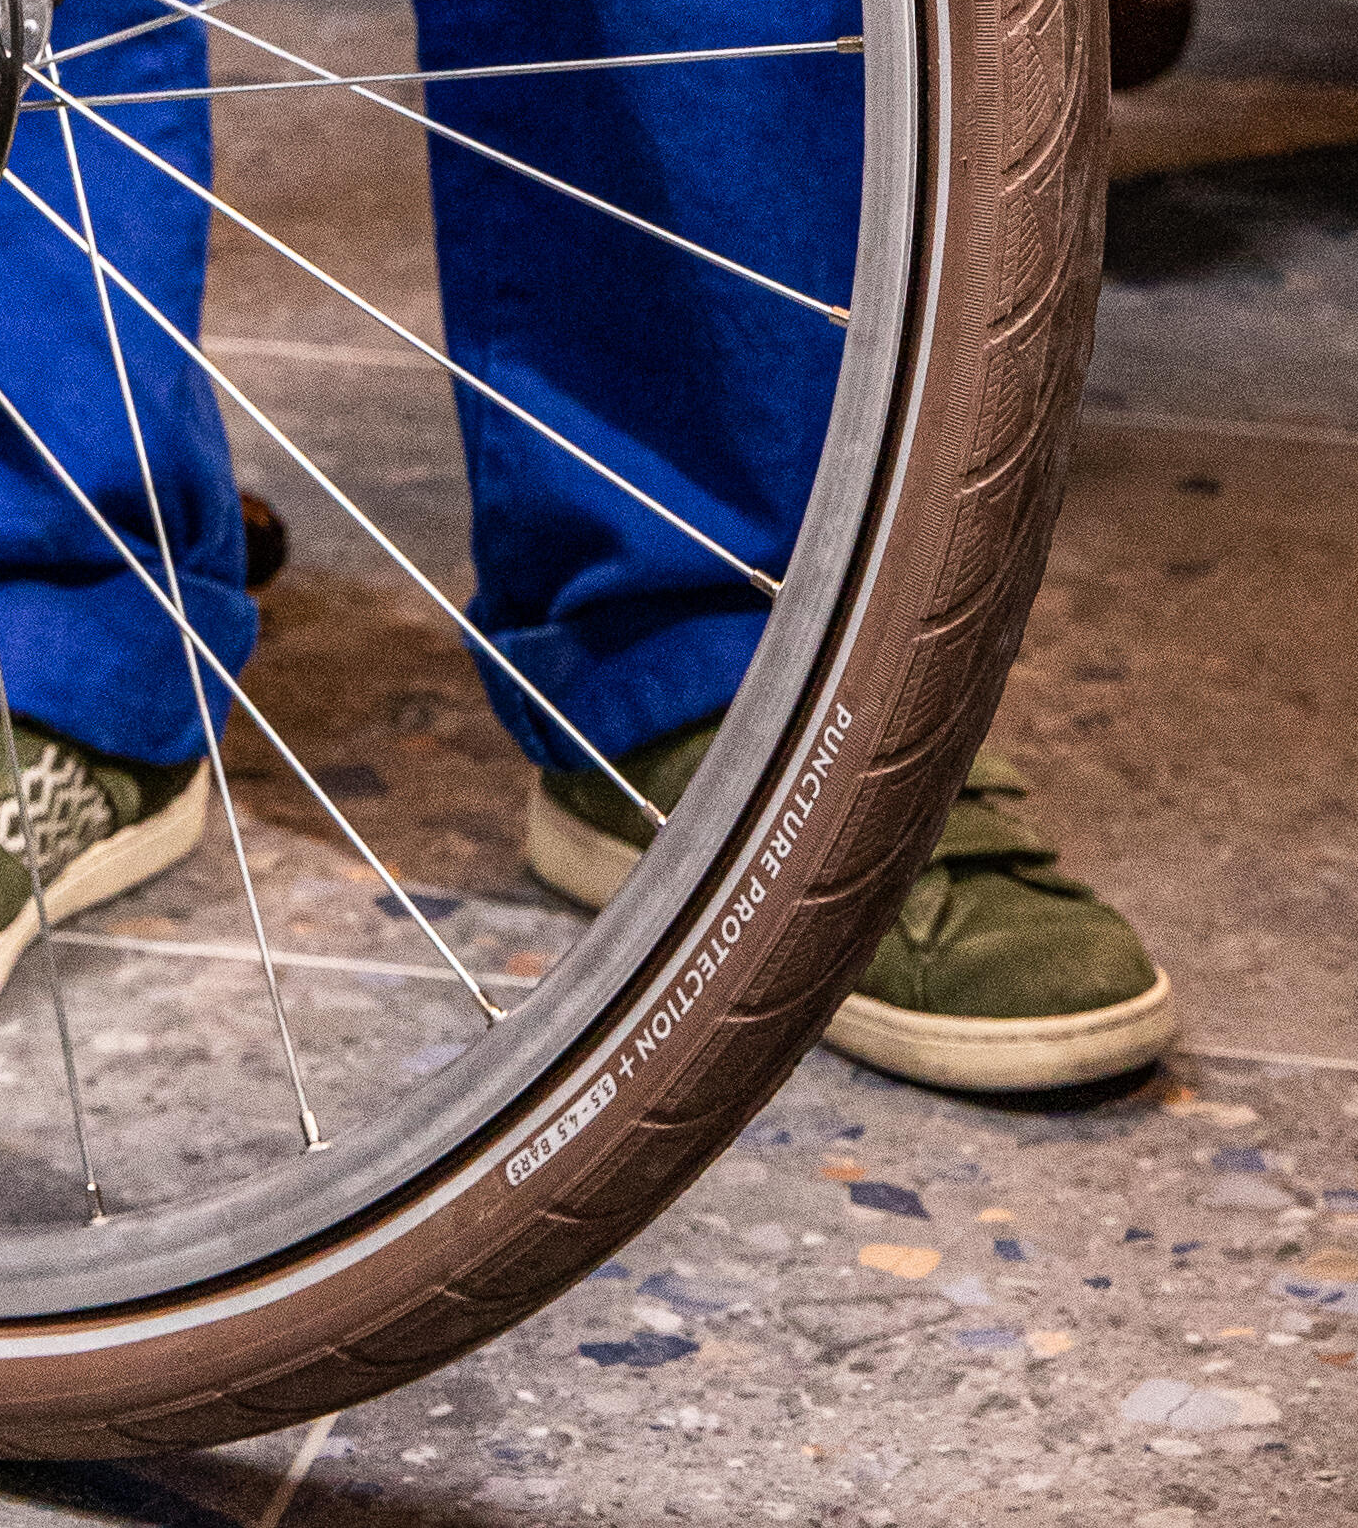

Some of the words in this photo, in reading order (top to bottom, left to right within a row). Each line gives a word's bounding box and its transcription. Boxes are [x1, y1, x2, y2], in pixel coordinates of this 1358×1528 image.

[760, 702, 853, 880] PUNCTURE
[635, 875, 767, 1062] PROTECTION
[590, 1079, 613, 1109] 3,5
[557, 1112, 579, 1141] 4,5
[511, 1138, 551, 1181] BARS
